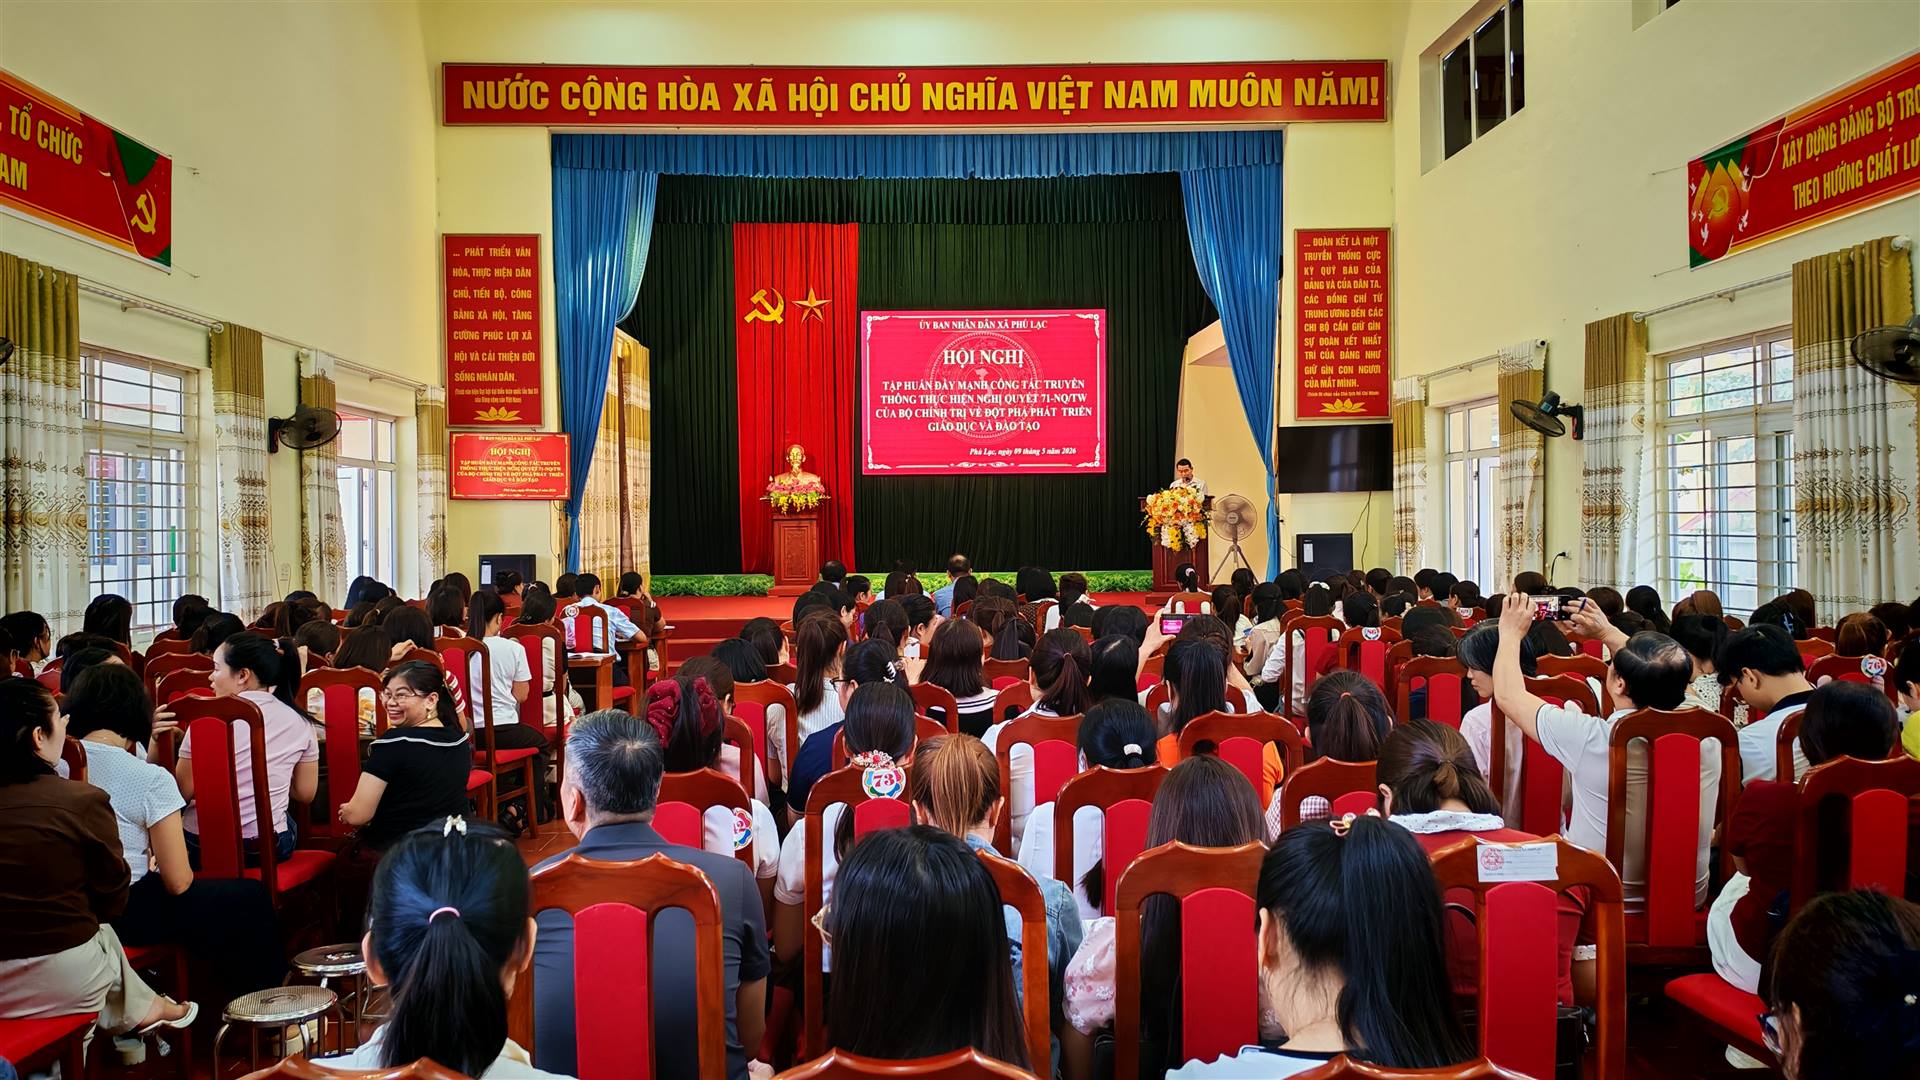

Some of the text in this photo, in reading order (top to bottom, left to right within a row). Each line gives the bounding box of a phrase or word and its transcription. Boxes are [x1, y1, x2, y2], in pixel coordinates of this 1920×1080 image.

[463, 71, 1378, 117] NƯỚC CỘNG HÒA XÃ HỘI CHỦ NGHĨA VIỆT NAM MUÔN NĂM!
[9, 102, 83, 165] TỔ CHỨC
[1782, 135, 1803, 169] XÂY
[1806, 121, 1837, 161] DỰNG
[1840, 104, 1873, 146] ĐẢNG
[1876, 90, 1895, 132] BỘ
[1792, 176, 1819, 210] THEO
[1824, 160, 1863, 200] HƯỚNG
[1867, 136, 1900, 184] CHẤT
[920, 319, 1048, 330] ỦY BAN NHÂN DÂN XÃ PHÚ LẠC
[943, 348, 1024, 369] HỘI NGHỊ
[882, 381, 902, 392] TẬP
[904, 379, 932, 390] HUẤN
[958, 380, 987, 392] MẠNH
[990, 378, 1019, 390] CÔNG
[1022, 378, 1042, 389] TÁC
[1044, 377, 1085, 389] TRUYỀN
[880, 392, 1087, 406] THÔNG THỰC HIỆN NGHỊ QUYẾT 71-NQ/TW
[876, 406, 1092, 420] CỦA BỘ CHÍNH TRỊ VỀ ĐỘT PHÁ PHÁT TRIỂN
[928, 420, 1040, 434] GIÁO DỤC VÀ ĐÀO TẠO
[1868, 662, 1881, 670] 76
[874, 774, 895, 787] 73
